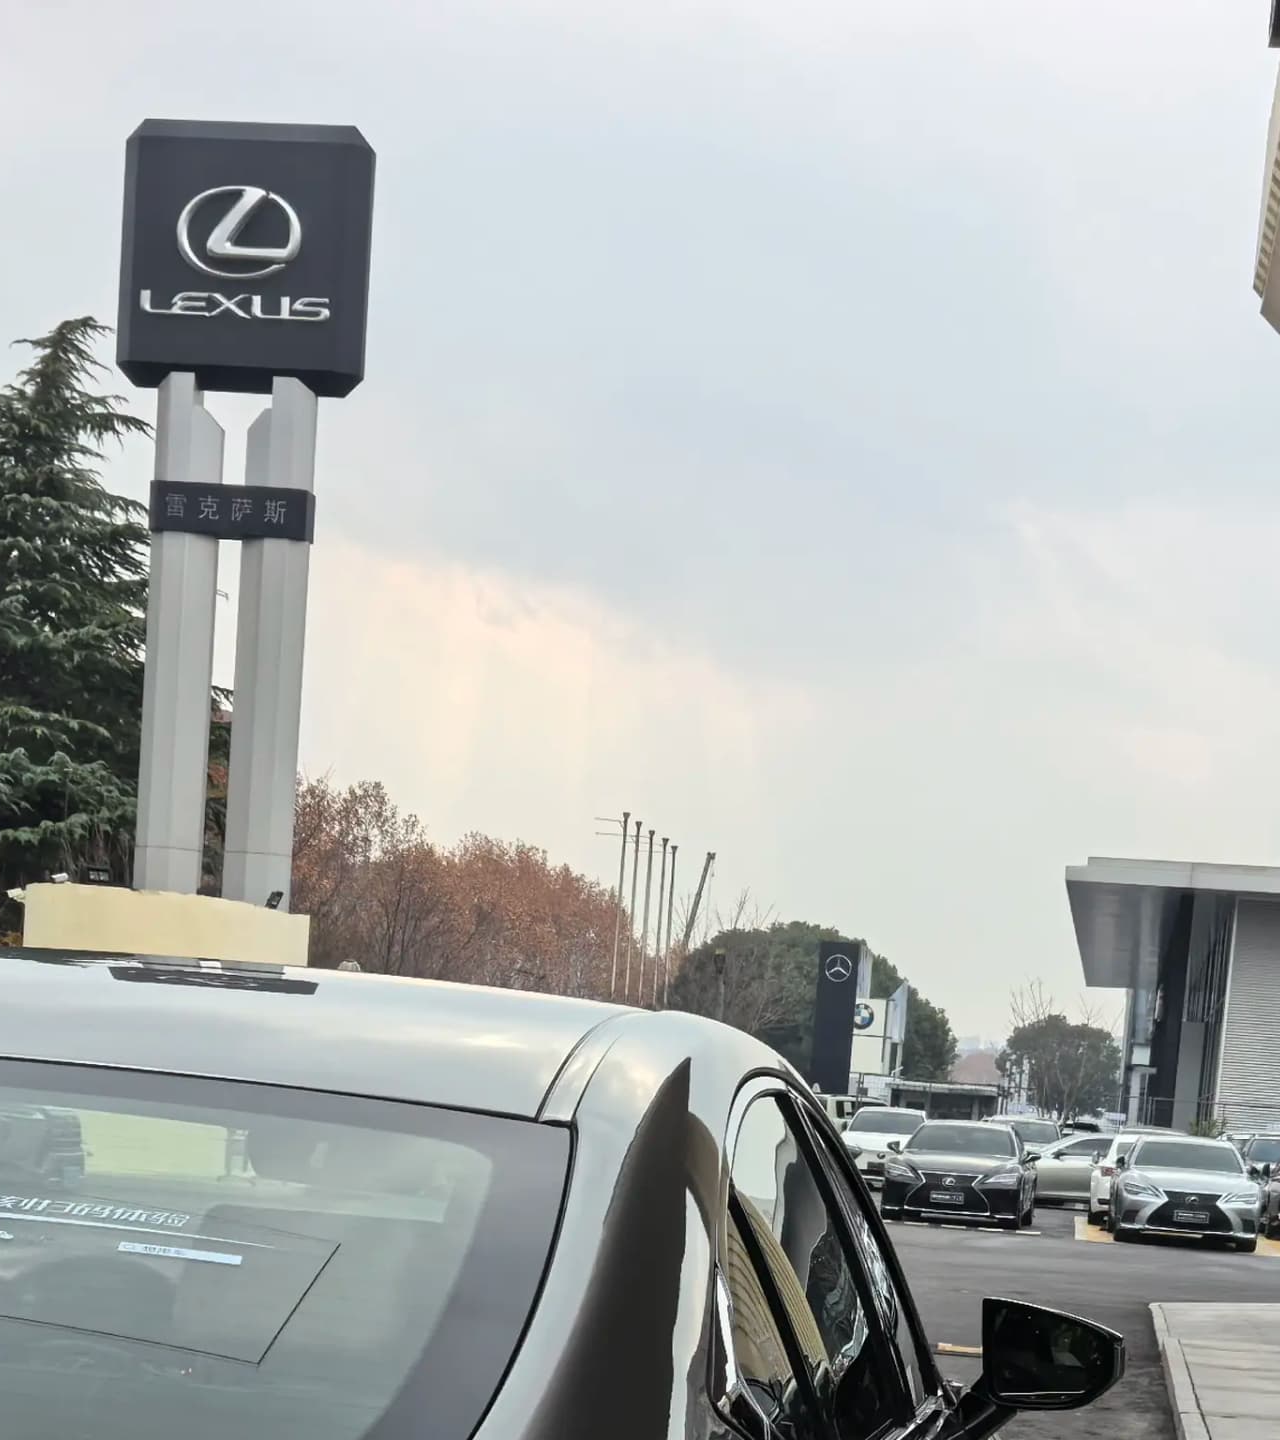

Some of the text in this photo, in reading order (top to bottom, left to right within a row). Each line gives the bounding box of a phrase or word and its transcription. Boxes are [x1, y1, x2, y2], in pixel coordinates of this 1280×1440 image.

[139, 289, 330, 321] LEXUS
[164, 493, 288, 524] 雷克萨斯
